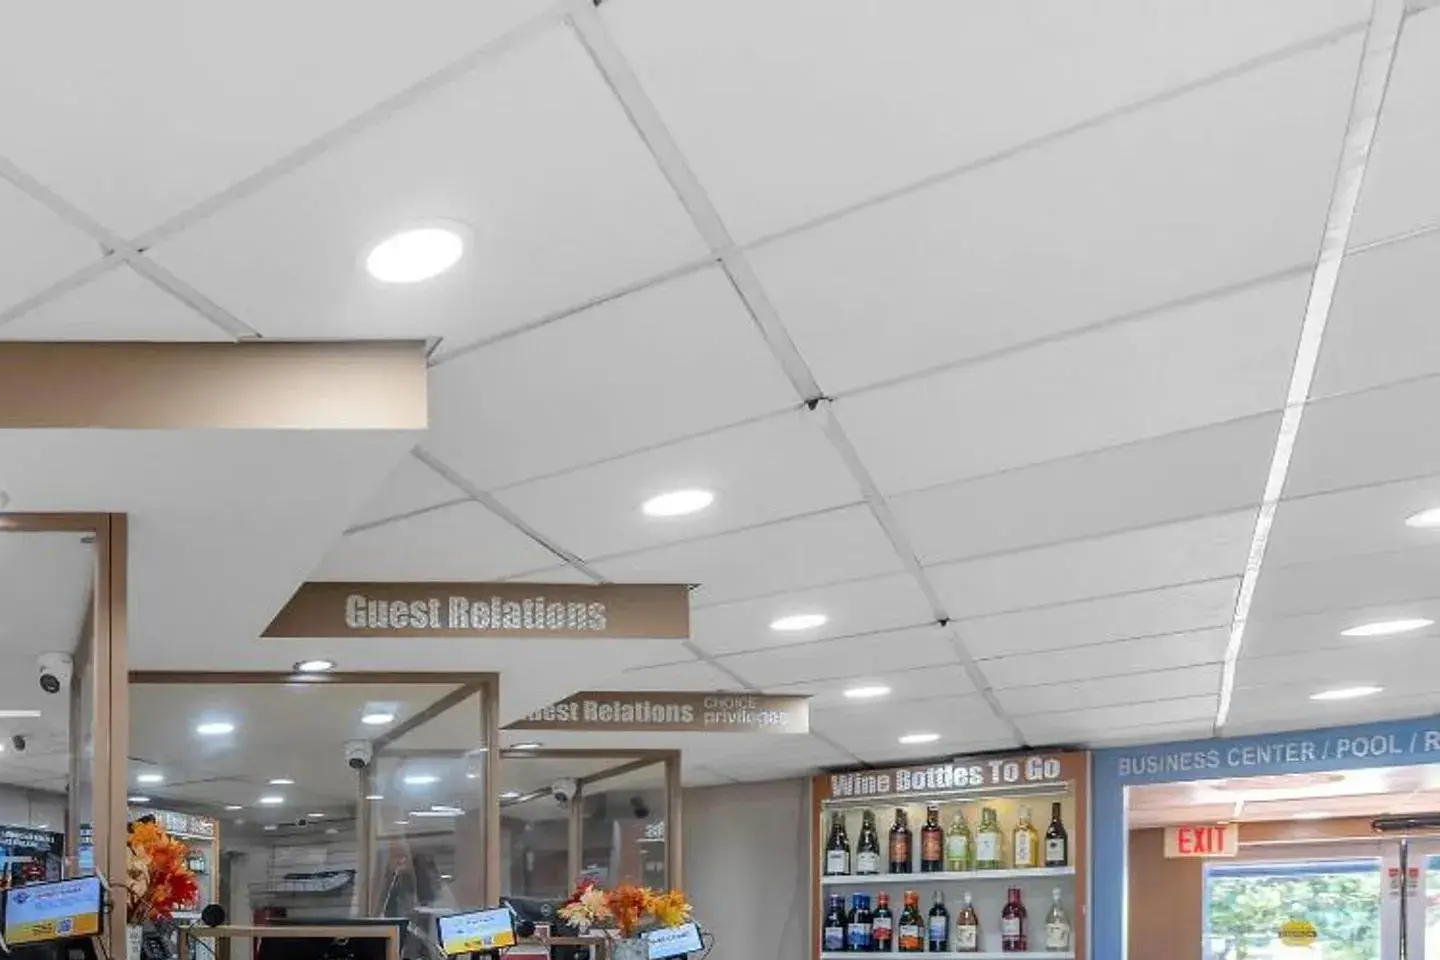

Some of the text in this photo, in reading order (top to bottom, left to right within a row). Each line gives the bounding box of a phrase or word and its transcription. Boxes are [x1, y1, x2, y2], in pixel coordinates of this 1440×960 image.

[345, 594, 607, 630] Guest Relations
[583, 699, 694, 724] Relations
[1118, 750, 1220, 776] BUSINESS
[1227, 740, 1316, 767] CENTER
[1336, 734, 1402, 759] POOL
[831, 755, 1061, 796] Wine Bottles To Go
[1177, 826, 1227, 855] EXIT
